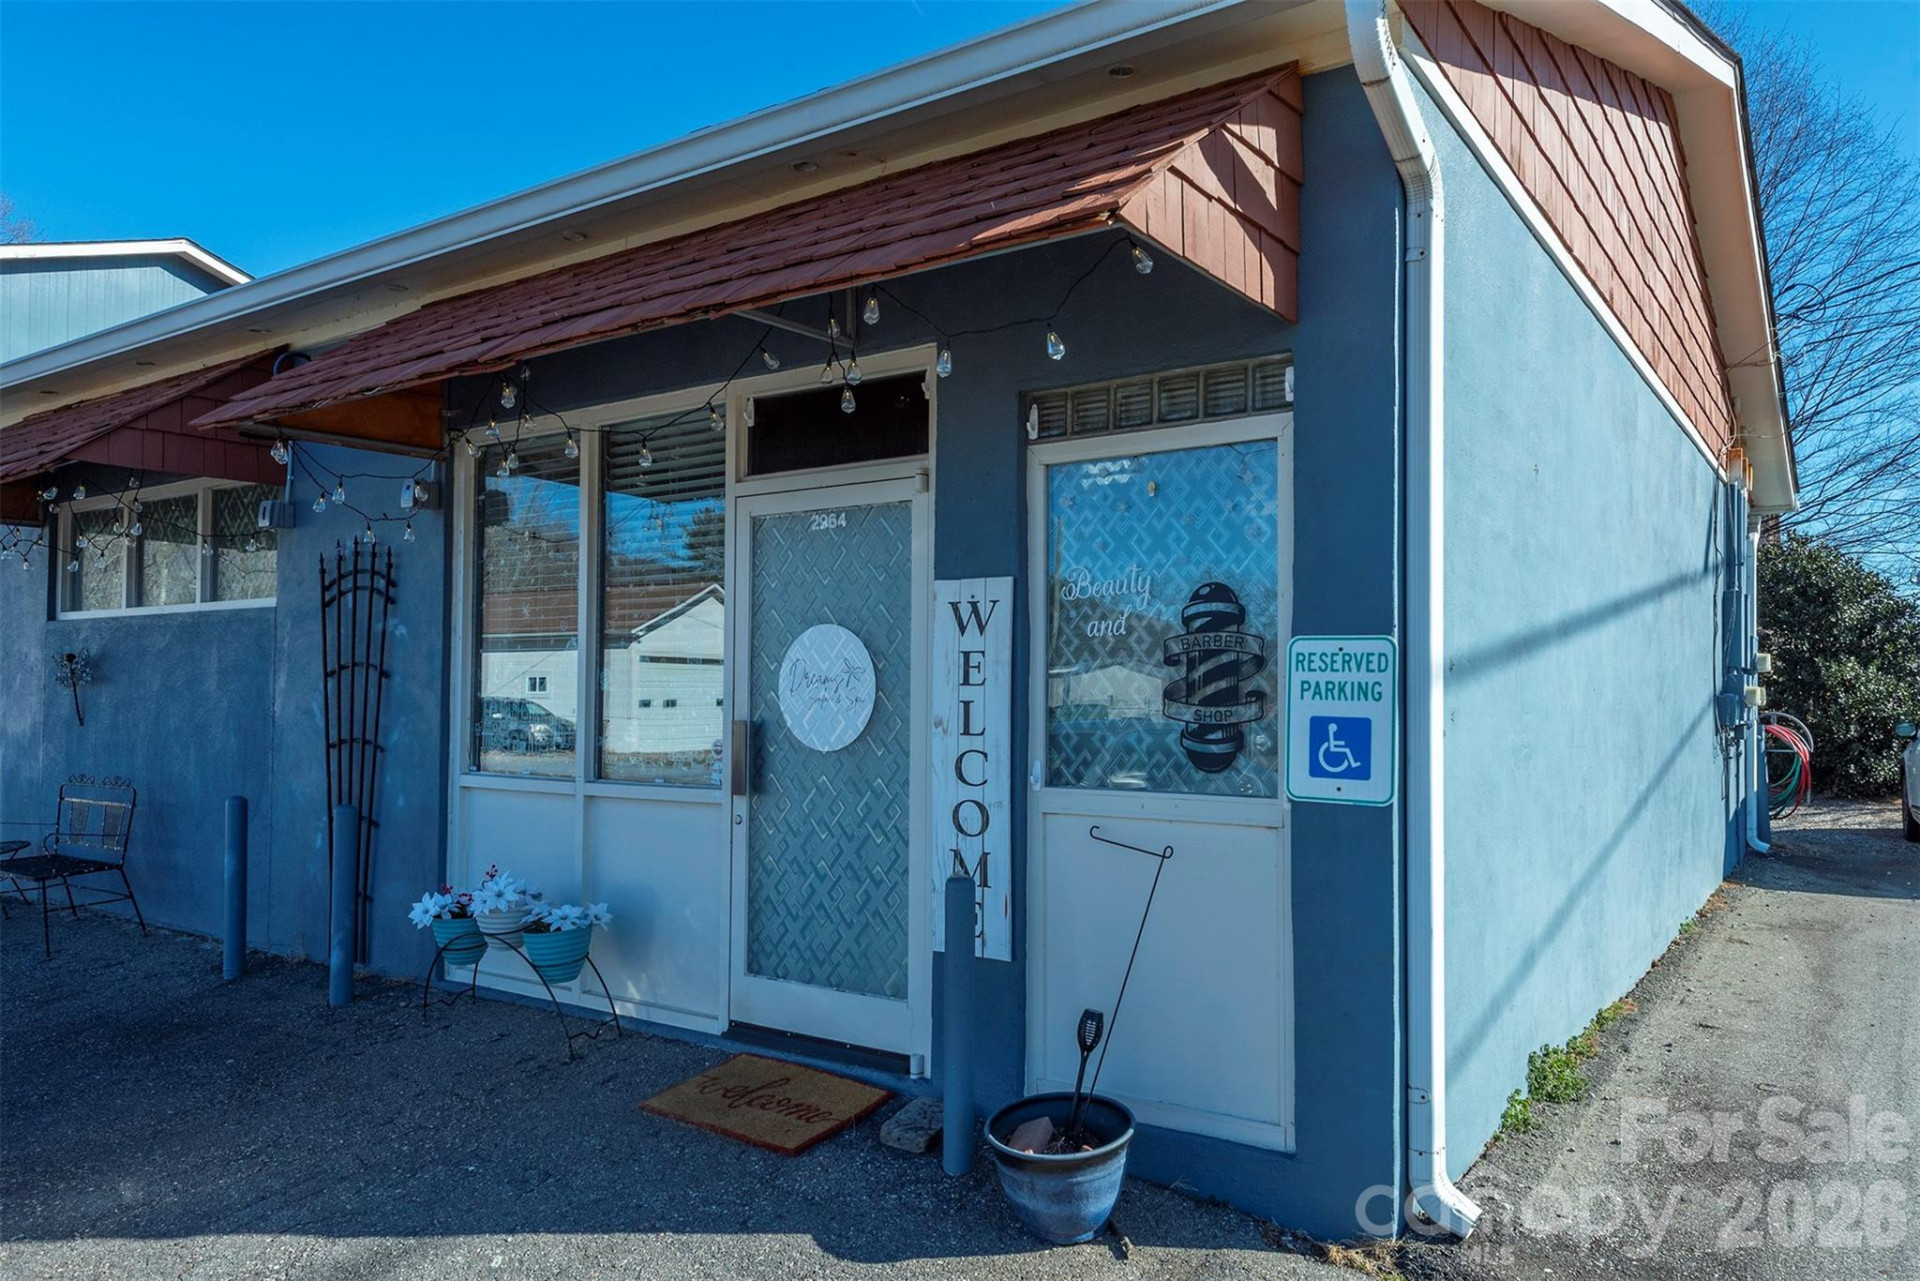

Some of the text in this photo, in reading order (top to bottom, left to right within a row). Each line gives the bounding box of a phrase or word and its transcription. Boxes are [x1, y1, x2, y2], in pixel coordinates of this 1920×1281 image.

[811, 512, 847, 530] 2964
[1061, 563, 1151, 611] Beauty
[1087, 604, 1132, 637] and
[1180, 634, 1245, 651] BARBER
[1295, 652, 1389, 673] RESERVED
[1300, 680, 1383, 702] PARKING
[1193, 709, 1234, 723] SHOP
